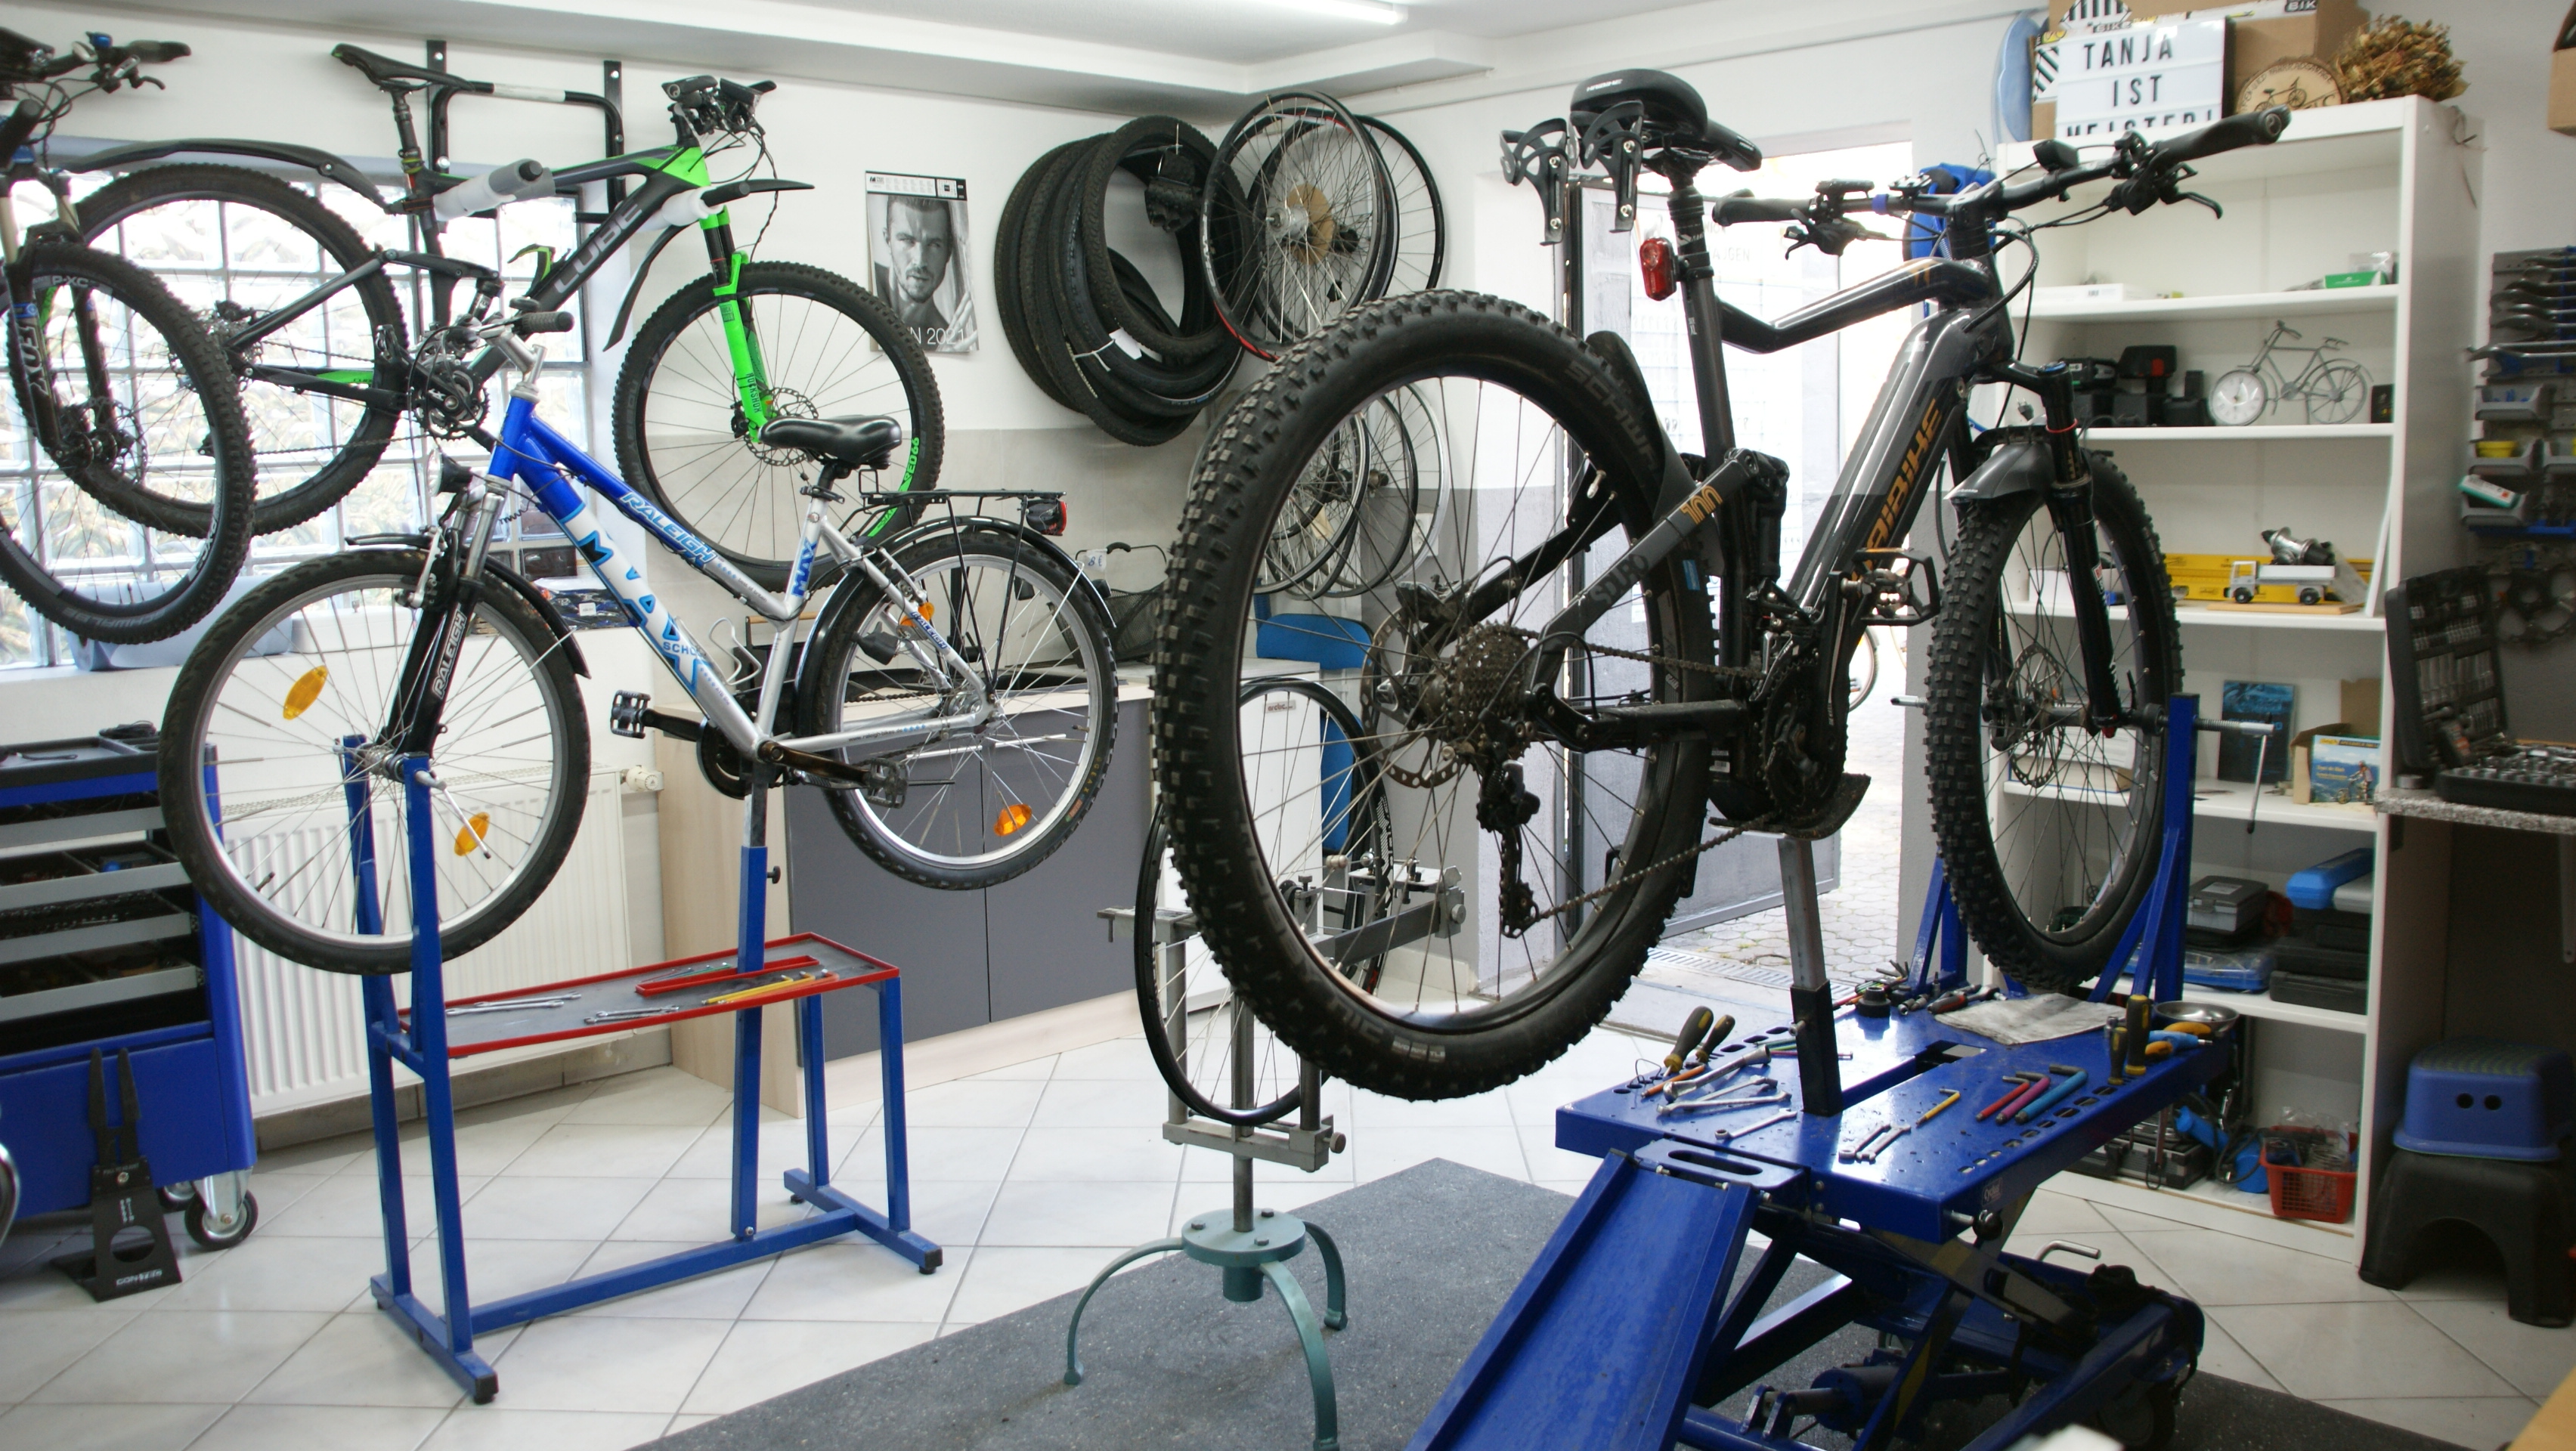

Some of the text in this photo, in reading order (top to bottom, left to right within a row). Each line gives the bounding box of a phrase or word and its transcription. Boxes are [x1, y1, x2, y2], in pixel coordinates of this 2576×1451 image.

[2083, 35, 2173, 70] TANJA
[2113, 74, 2162, 107] IST
[927, 328, 965, 345] 2021
[620, 492, 718, 563] RALEIGH
[791, 537, 818, 597] MAX
[912, 611, 946, 648] RALEIGH
[432, 609, 468, 700] RALEIGH
